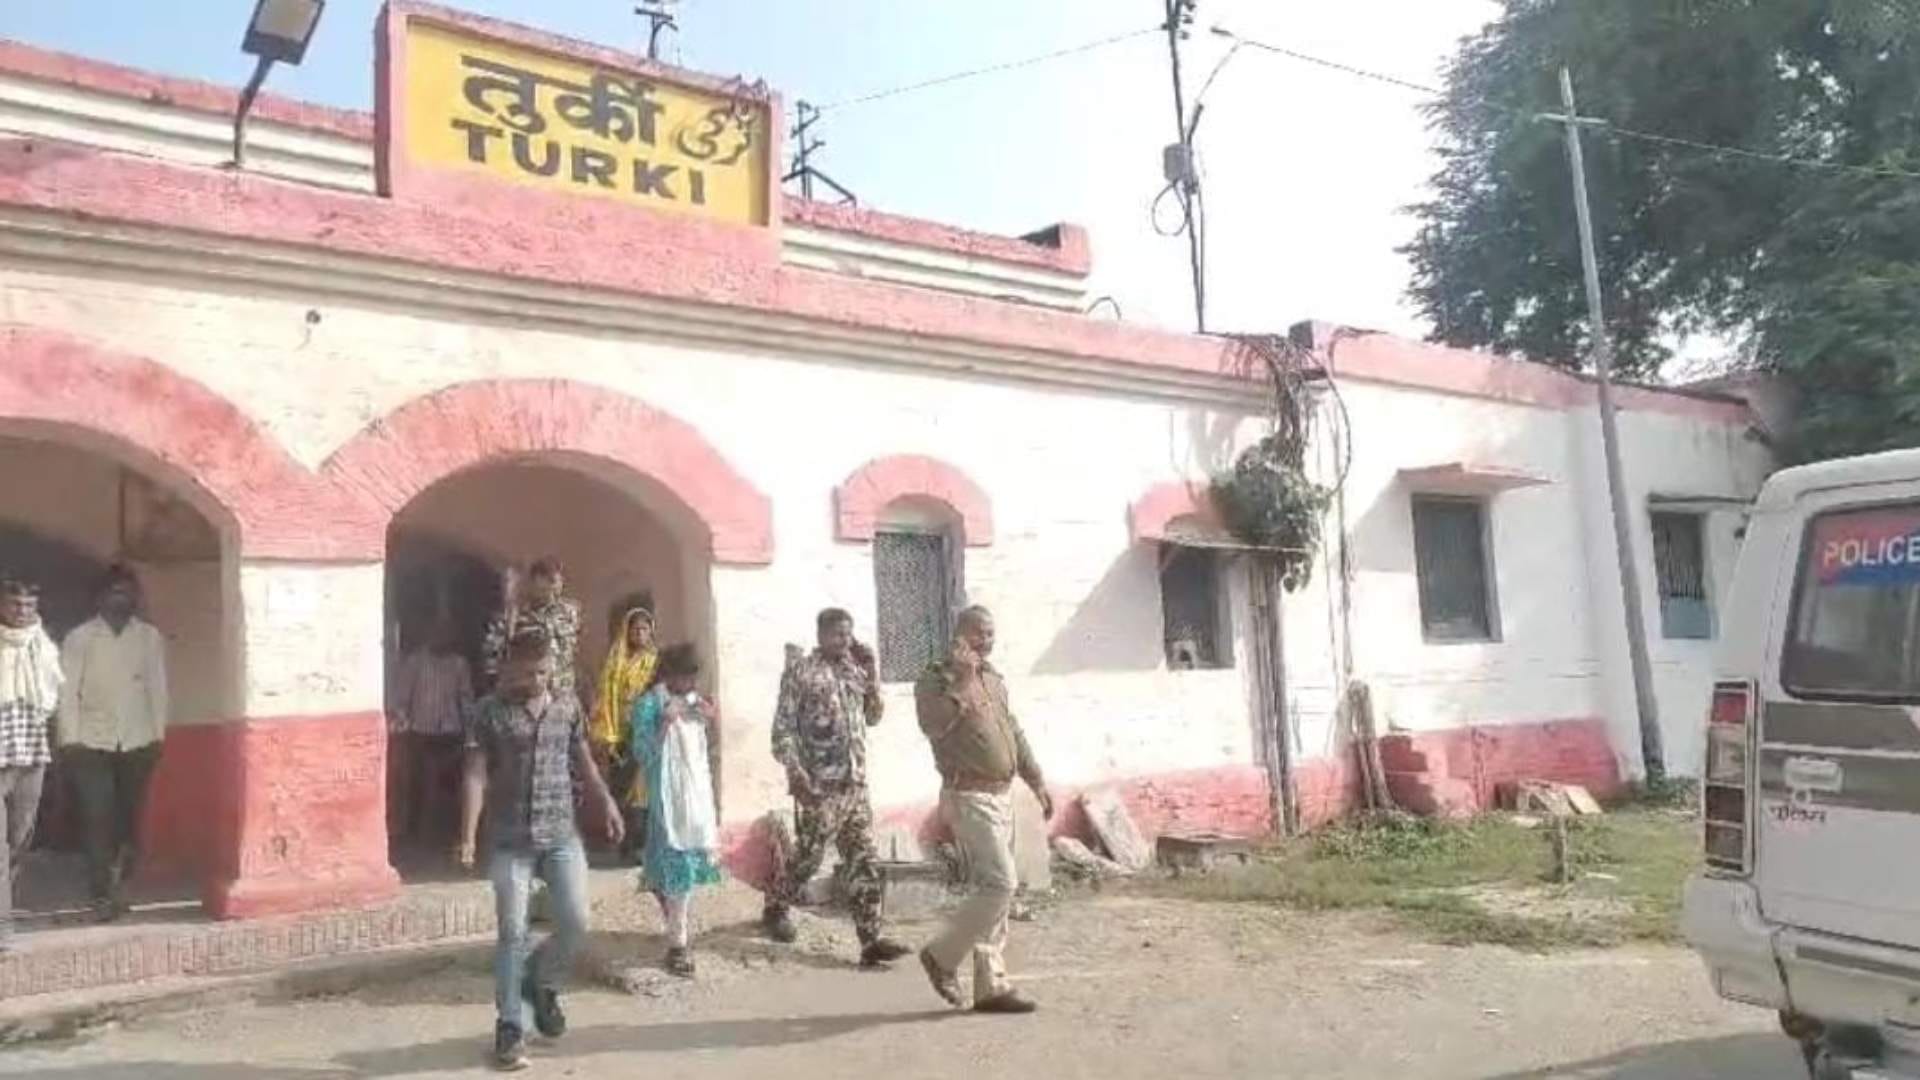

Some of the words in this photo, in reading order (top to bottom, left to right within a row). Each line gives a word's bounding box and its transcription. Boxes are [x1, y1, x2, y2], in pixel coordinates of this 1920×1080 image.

[461, 55, 664, 145] तुर्की
[451, 119, 706, 204] TURKI
[1823, 536, 1920, 567] POLICE
